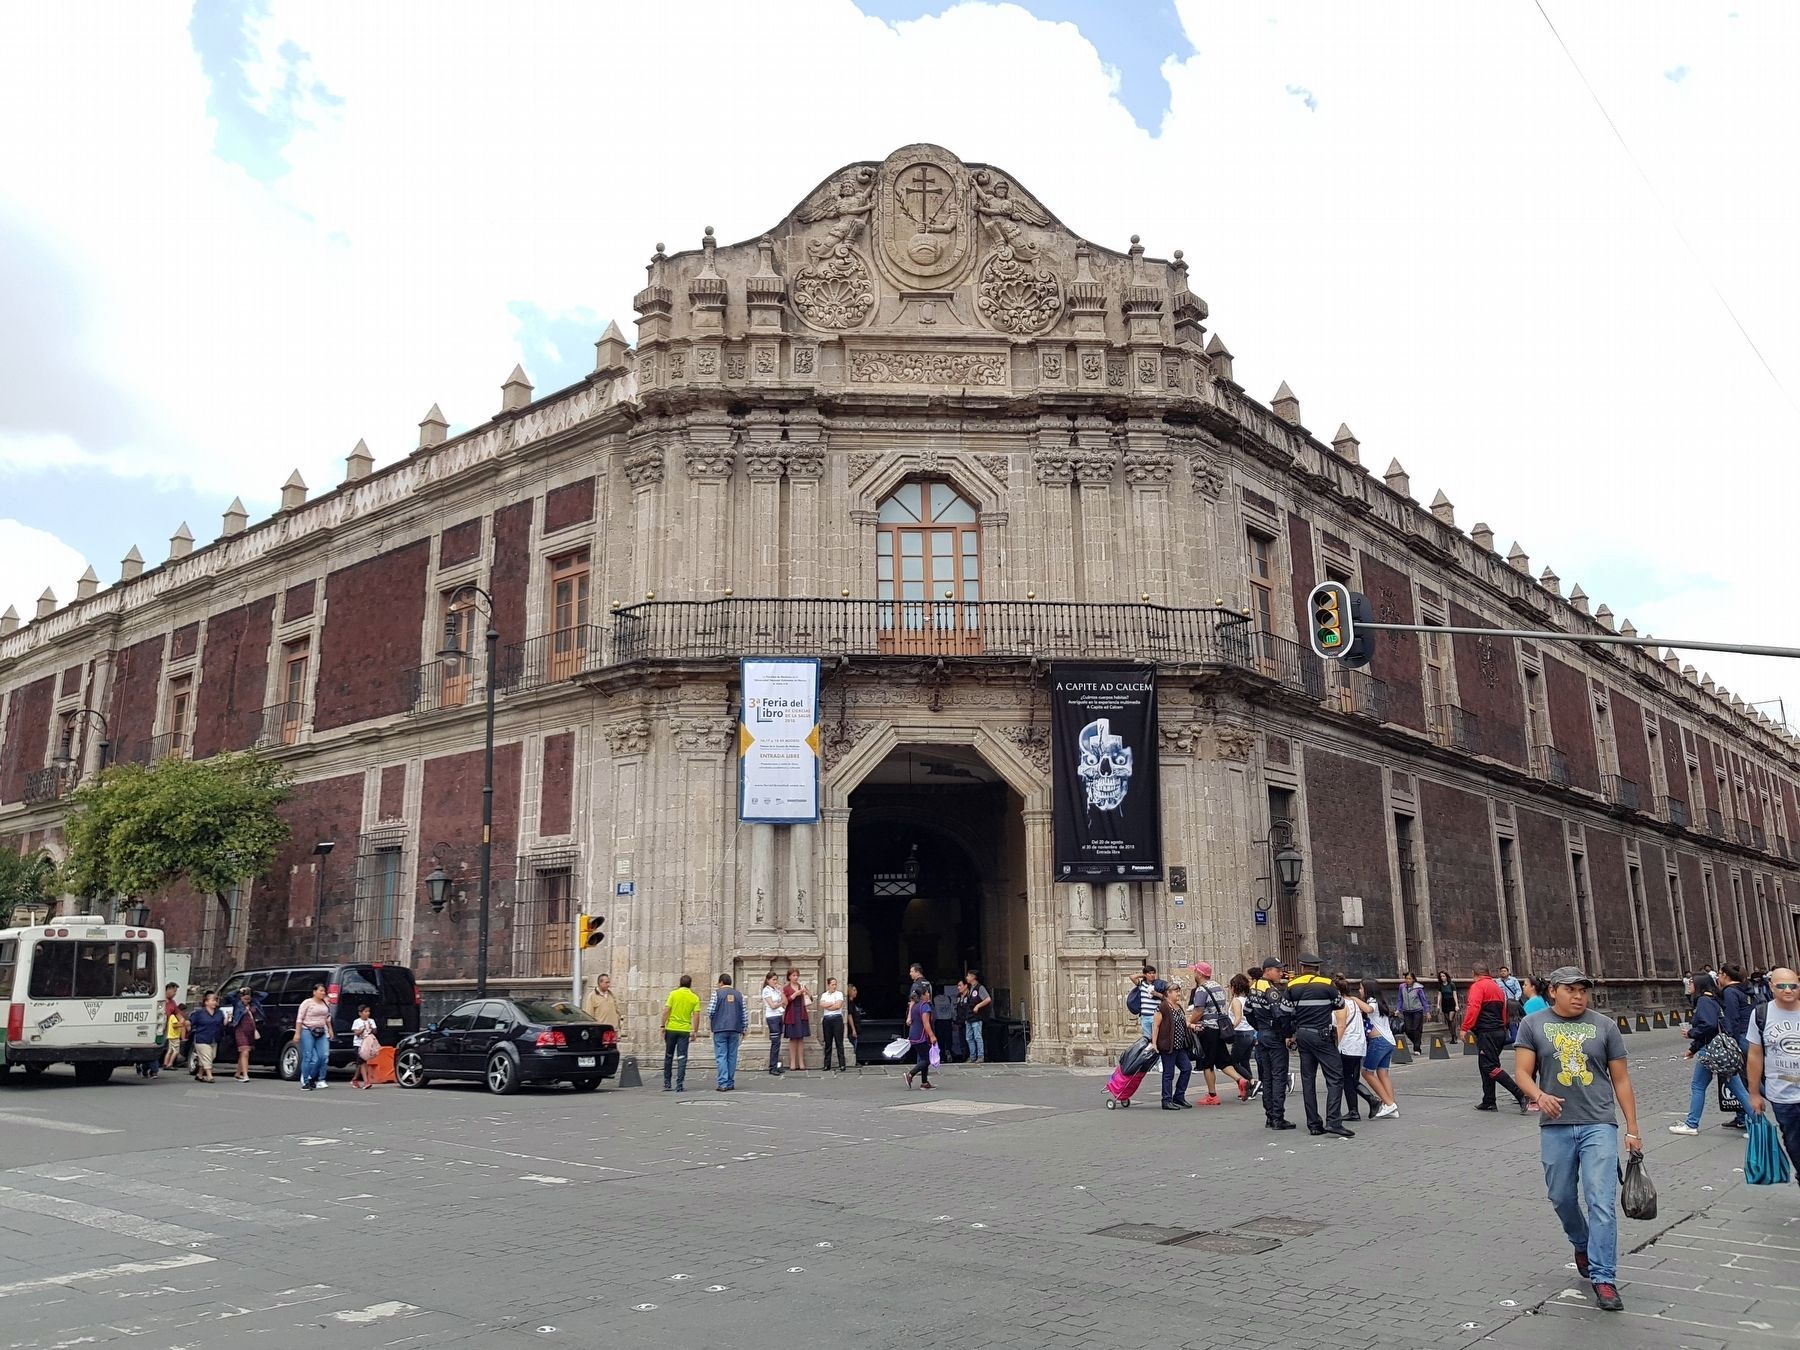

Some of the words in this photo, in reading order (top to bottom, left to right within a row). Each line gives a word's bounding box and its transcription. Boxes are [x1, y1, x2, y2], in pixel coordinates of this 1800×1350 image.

[1056, 682, 1063, 691] A
[1065, 682, 1097, 691] CAPITE
[1100, 683, 1113, 691] AD
[1116, 683, 1153, 691] CALCEM
[763, 697, 788, 707] Feria
[790, 699, 803, 707] del
